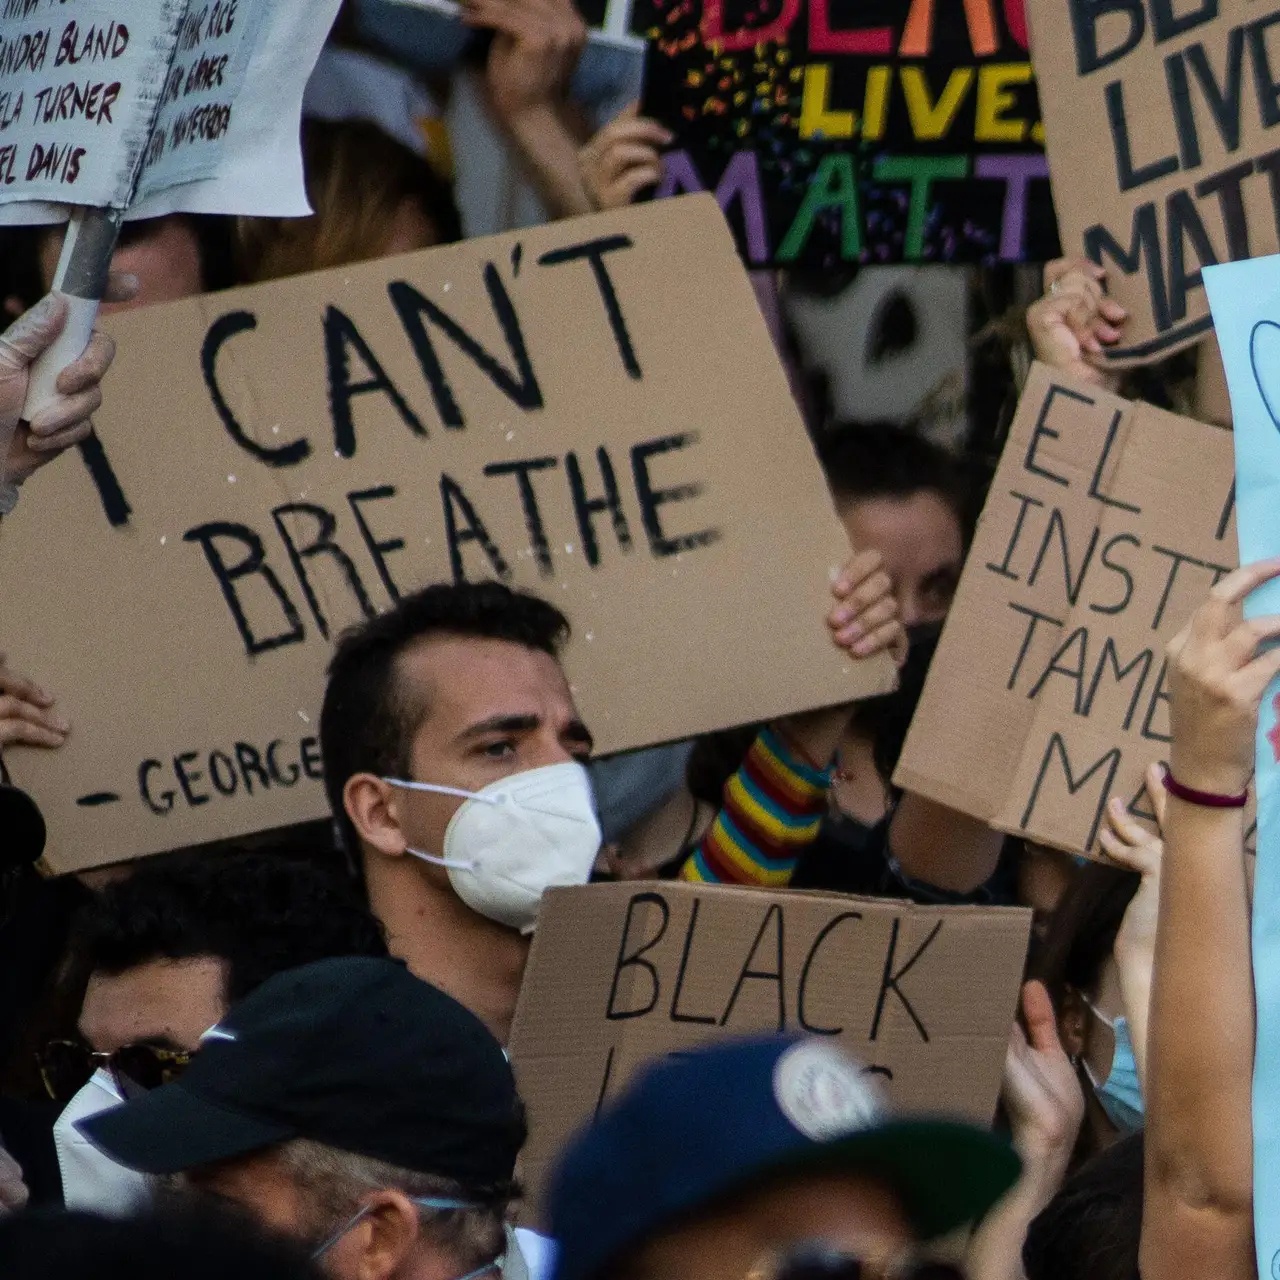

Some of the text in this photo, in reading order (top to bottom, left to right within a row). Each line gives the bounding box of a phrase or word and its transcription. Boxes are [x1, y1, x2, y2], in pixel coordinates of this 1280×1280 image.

[34, 79, 122, 126] TURNER
[54, 19, 130, 67] BLAND
[800, 62, 1047, 143] LIVE
[25, 142, 87, 184] DAVIS
[201, 234, 643, 467] CAN'T
[1023, 384, 1141, 513] EL
[183, 431, 722, 656] BREATHE
[985, 490, 1235, 630] INST
[605, 892, 943, 1043] BLACK
